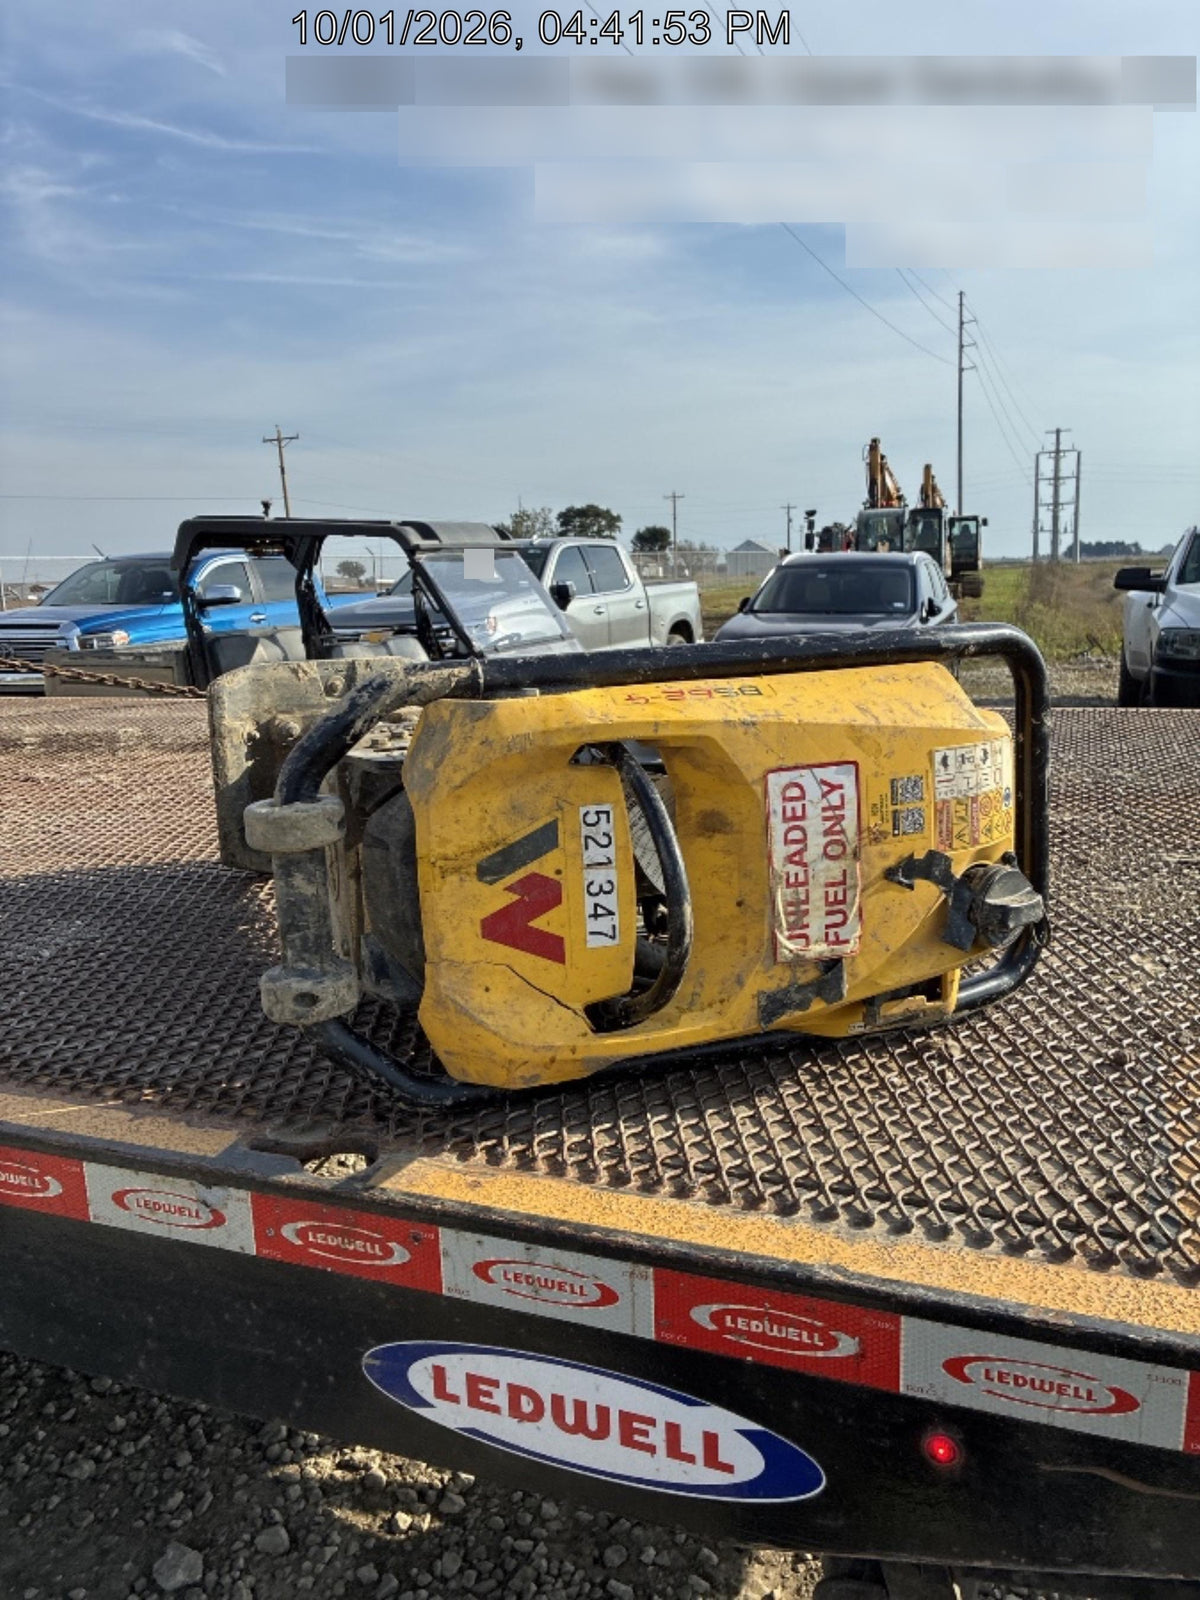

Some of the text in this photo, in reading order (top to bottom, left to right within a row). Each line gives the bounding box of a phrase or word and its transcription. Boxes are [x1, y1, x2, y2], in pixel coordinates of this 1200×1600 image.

[818, 777, 848, 947] FUEL ONLY
[135, 1197, 203, 1220] LEDWELL
[308, 1230, 383, 1257] LEDWELL
[502, 1268, 588, 1297] LEDWELL
[724, 1314, 825, 1347] LEDWELL
[984, 1367, 1098, 1403] LEDWELL
[433, 1364, 736, 1474] LEDWELL
